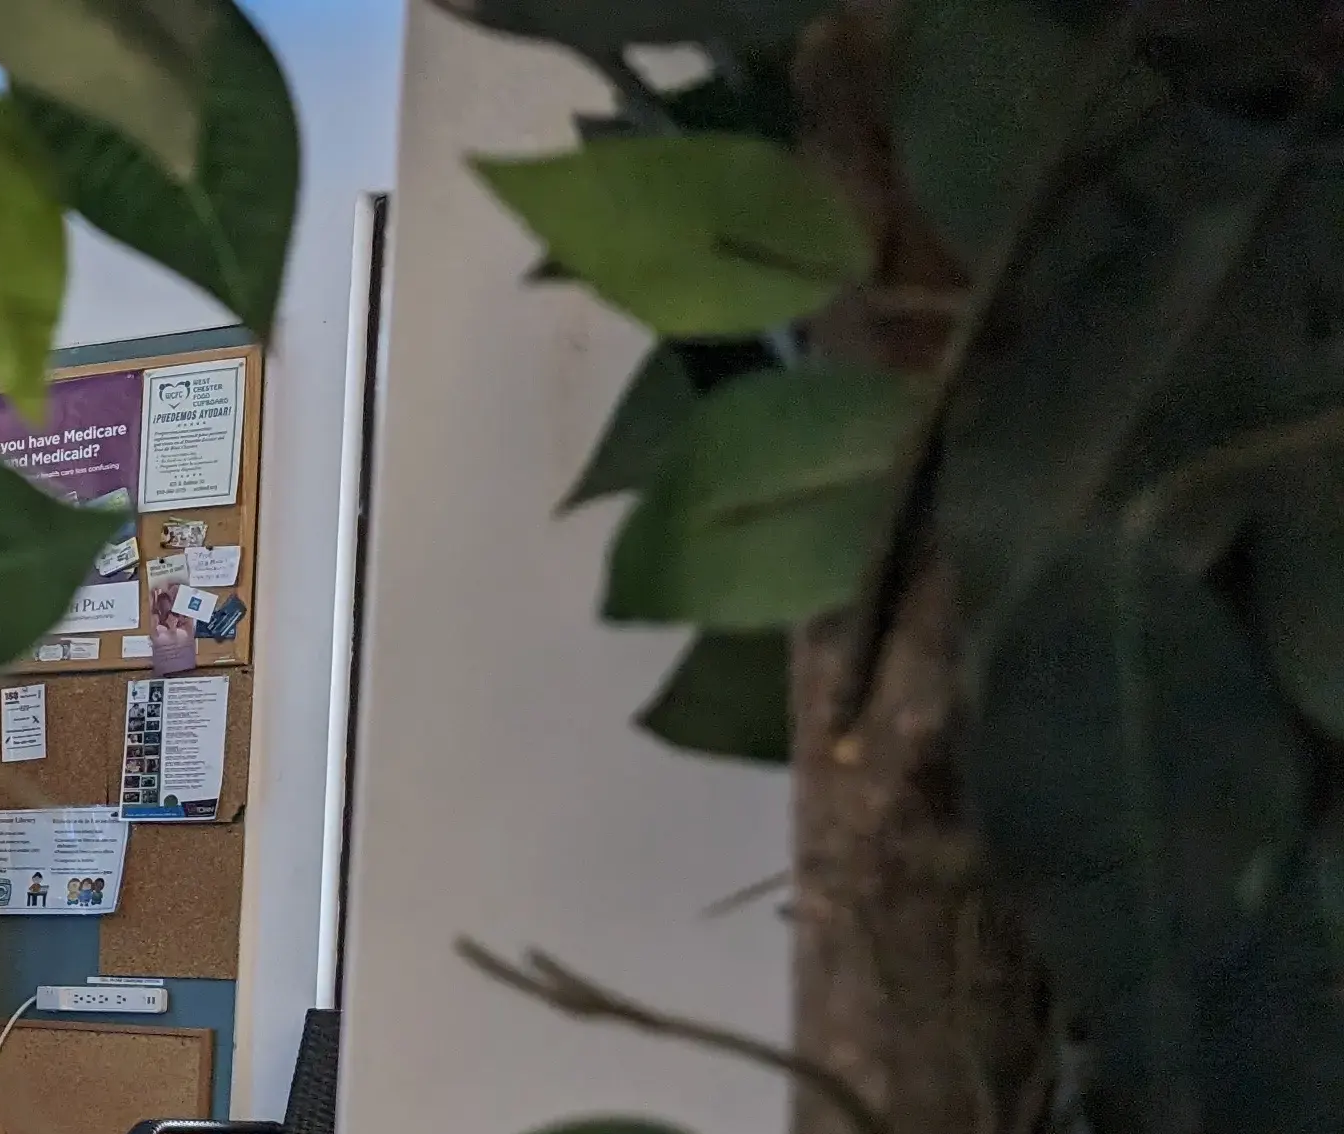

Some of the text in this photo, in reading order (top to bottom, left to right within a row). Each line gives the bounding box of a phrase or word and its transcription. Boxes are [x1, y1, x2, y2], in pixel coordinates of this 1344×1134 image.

[198, 406, 232, 419] AYUDAR!
[0, 439, 25, 455] you
[28, 434, 61, 449] have
[63, 424, 128, 444] Medicare
[31, 443, 101, 466] Medicaid?
[88, 462, 120, 474] confusing
[82, 598, 115, 612] PLAN
